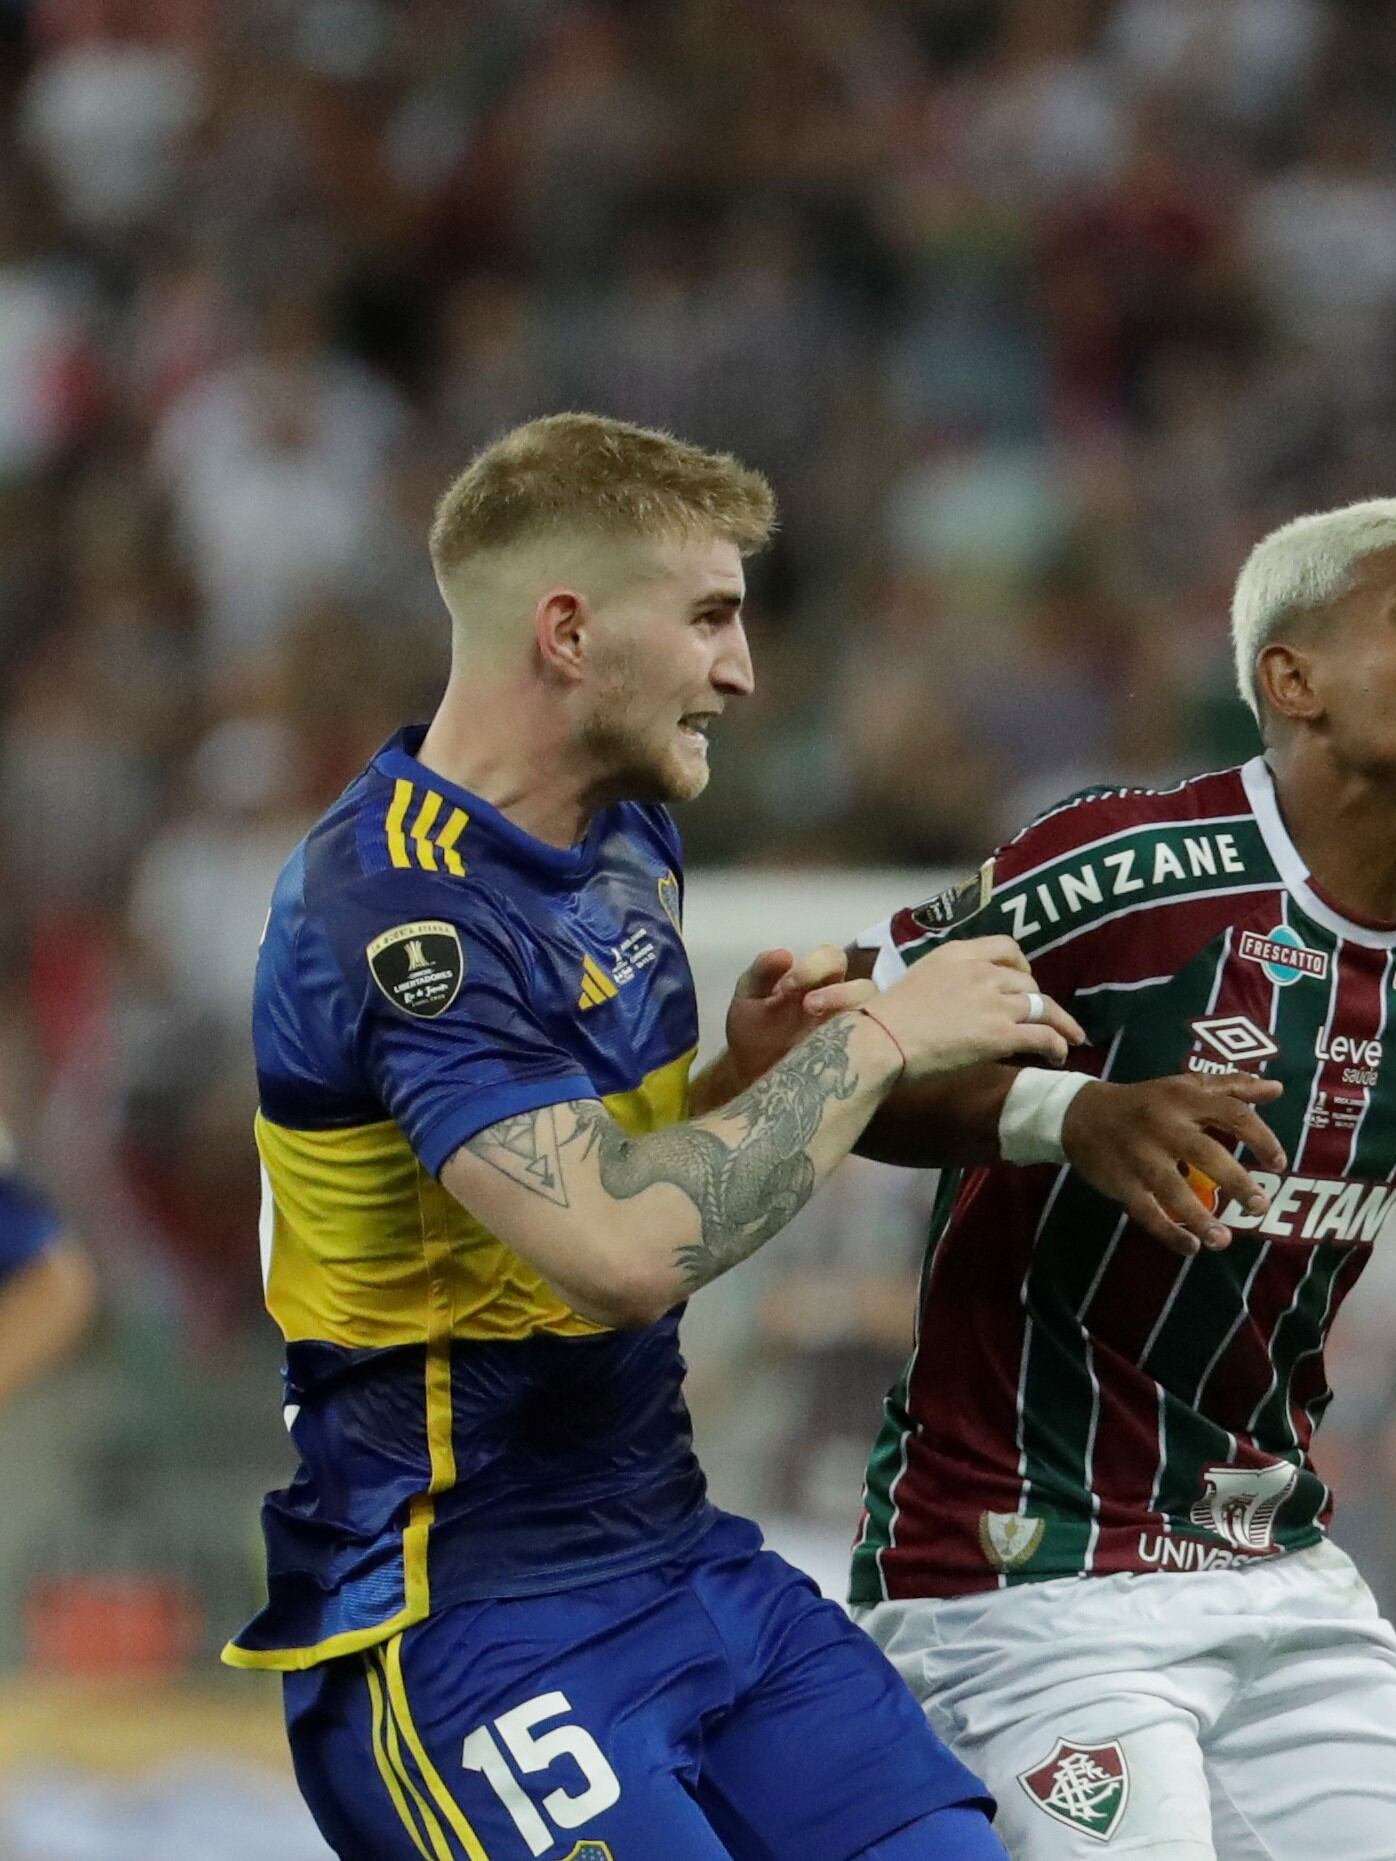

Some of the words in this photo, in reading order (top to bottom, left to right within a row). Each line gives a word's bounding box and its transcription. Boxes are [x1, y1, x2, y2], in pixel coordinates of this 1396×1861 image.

[1000, 833, 1245, 941] ZINZANE
[1244, 937, 1322, 973] FRESCATTO
[1187, 1055, 1255, 1077] umb
[1314, 1025, 1383, 1068] Leve
[1341, 1066, 1379, 1087] saúde
[461, 1690, 622, 1858] 15
